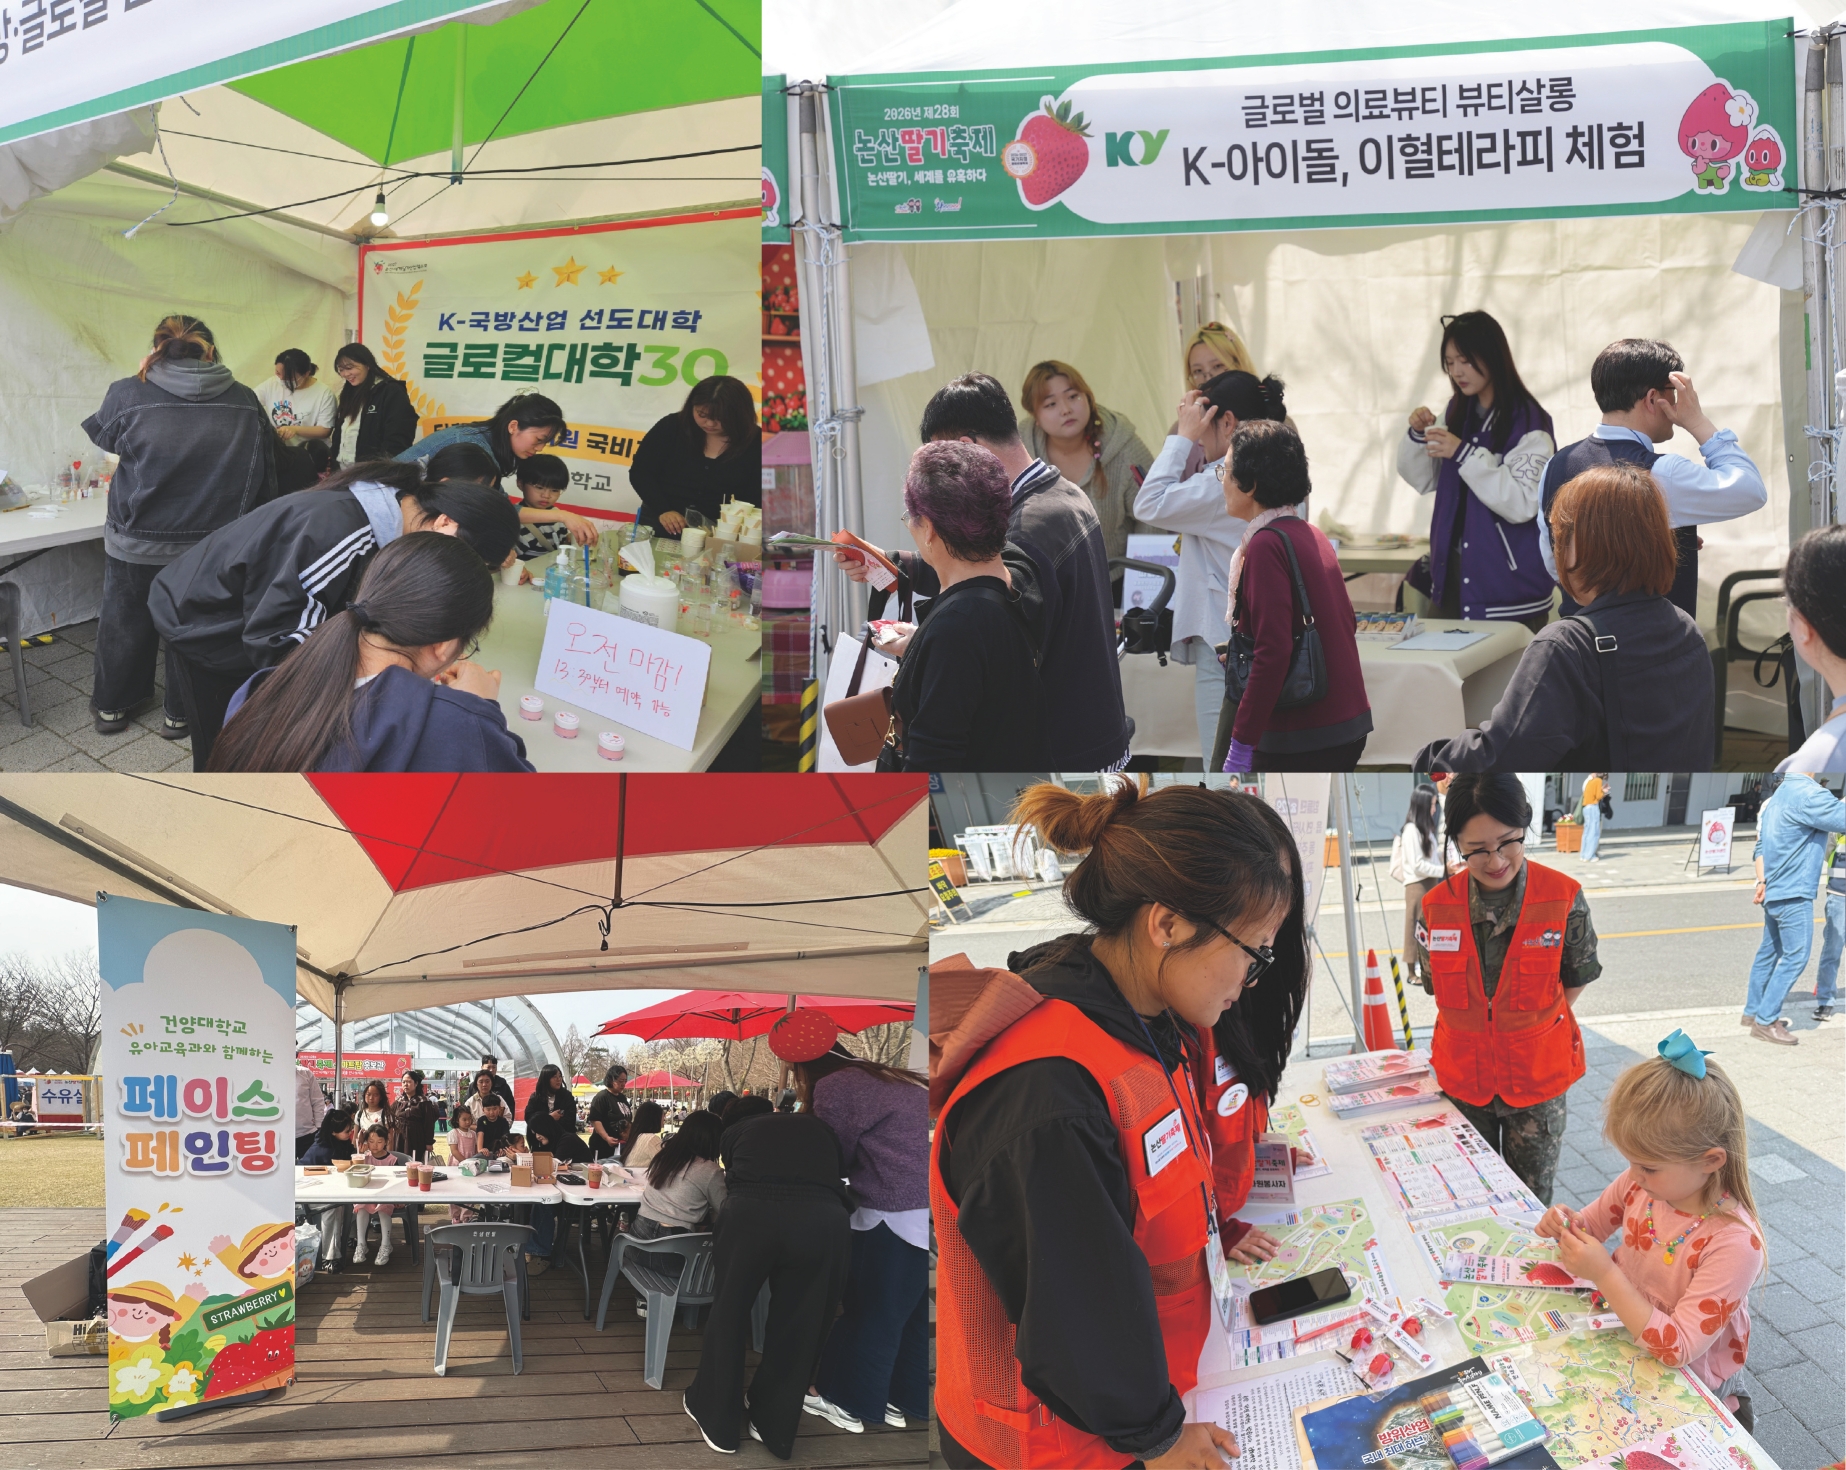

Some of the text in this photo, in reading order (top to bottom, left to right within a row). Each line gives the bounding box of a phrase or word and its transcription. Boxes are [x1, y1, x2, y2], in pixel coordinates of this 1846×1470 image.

[884, 104, 960, 121] 2026년 제28회
[1241, 76, 1577, 129] 글로벌 의료뷰티 뷰티살롱
[853, 124, 997, 167] 논산딸기축제
[1182, 120, 1645, 188] K-아이돌, 이혈테라피 체험
[867, 168, 987, 186] 논산딸기, 세계를 유혹하다
[438, 308, 703, 334] K-국방산업 선도대학
[564, 622, 684, 693] 오전 마감!
[616, 686, 643, 711] 예약
[652, 699, 672, 718] 가능
[160, 1015, 247, 1037] 건양대학교
[129, 1041, 274, 1065] 유아교육과와 함께하는
[122, 1074, 281, 1120] 페이스
[124, 1130, 277, 1173] 페인팅
[1150, 1121, 1181, 1154] 논산딸기축제
[1254, 1159, 1286, 1168] 딸기축제
[210, 1290, 278, 1325] STRAWBERRY
[1482, 1399, 1502, 1420] NAME
[1376, 1418, 1431, 1445] 방위산업
[1361, 1434, 1428, 1465] 국내 최대 허브
